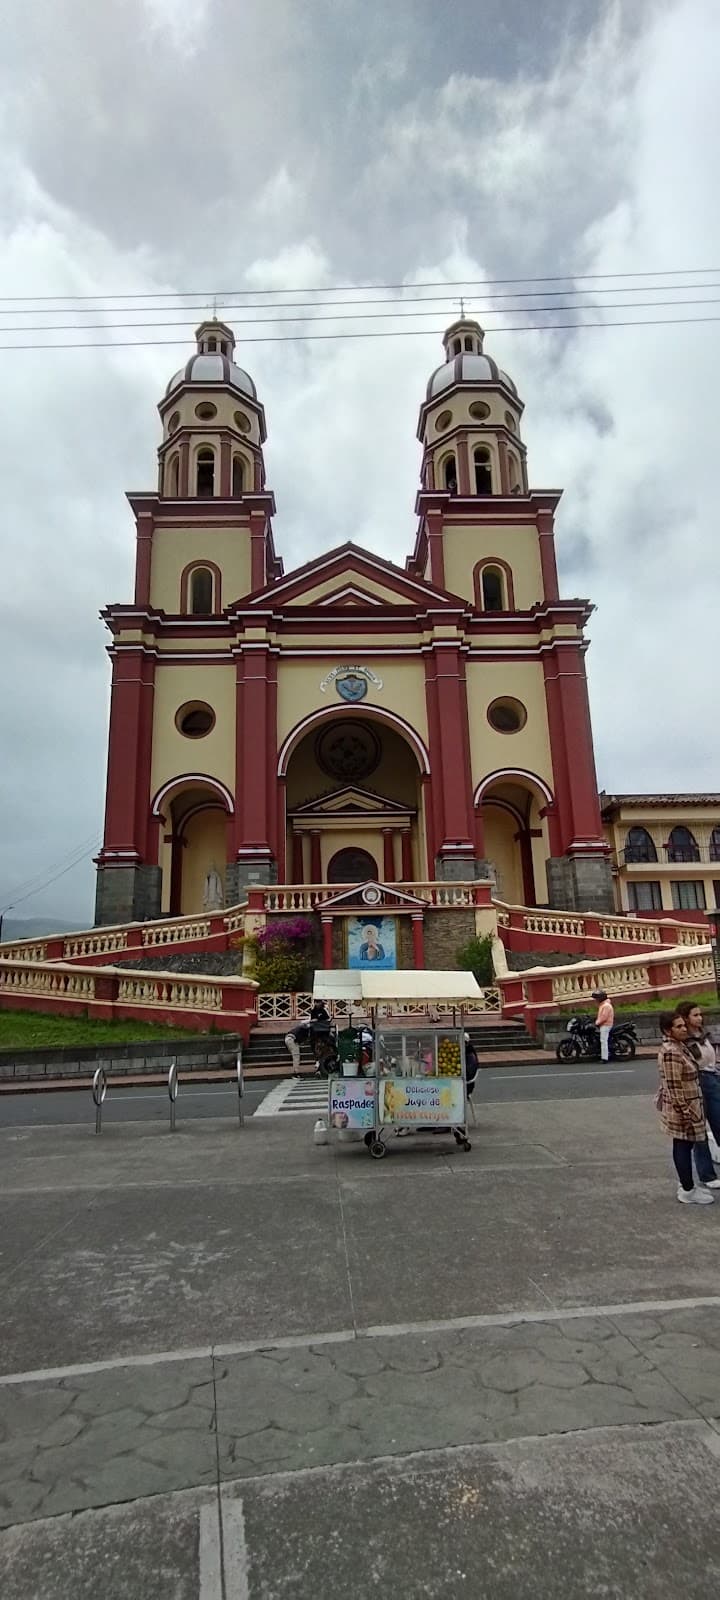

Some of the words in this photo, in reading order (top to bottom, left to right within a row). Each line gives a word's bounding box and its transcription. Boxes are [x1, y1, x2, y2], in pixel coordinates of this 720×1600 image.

[332, 1099, 375, 1110] Raspados
[405, 1098, 427, 1107] Jugo
[429, 1098, 441, 1106] de
